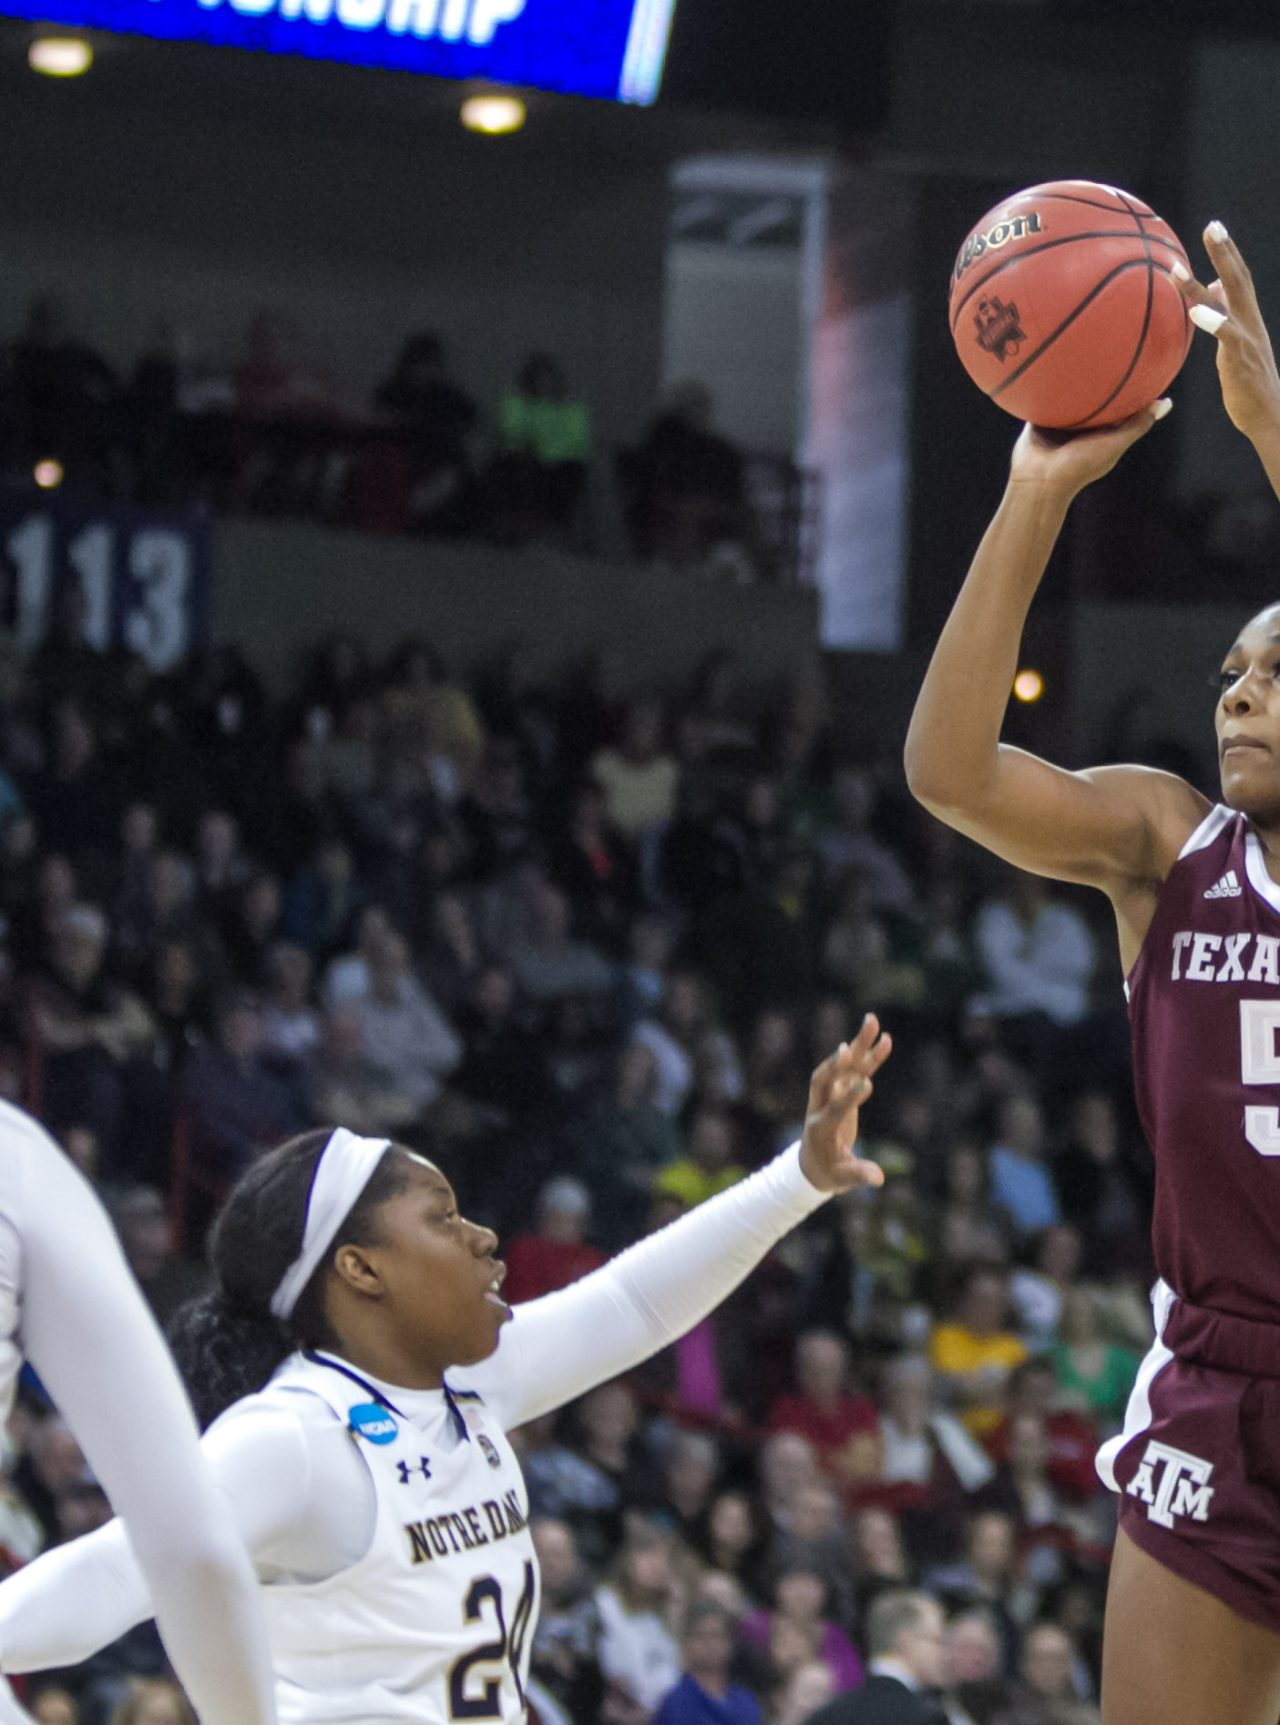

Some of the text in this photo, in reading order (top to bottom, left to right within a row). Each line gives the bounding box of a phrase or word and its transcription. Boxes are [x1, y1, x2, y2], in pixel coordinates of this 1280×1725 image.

[8, 516, 187, 672] 113
[358, 1419, 397, 1435] NCAA
[404, 1506, 489, 1565] NOTRE
